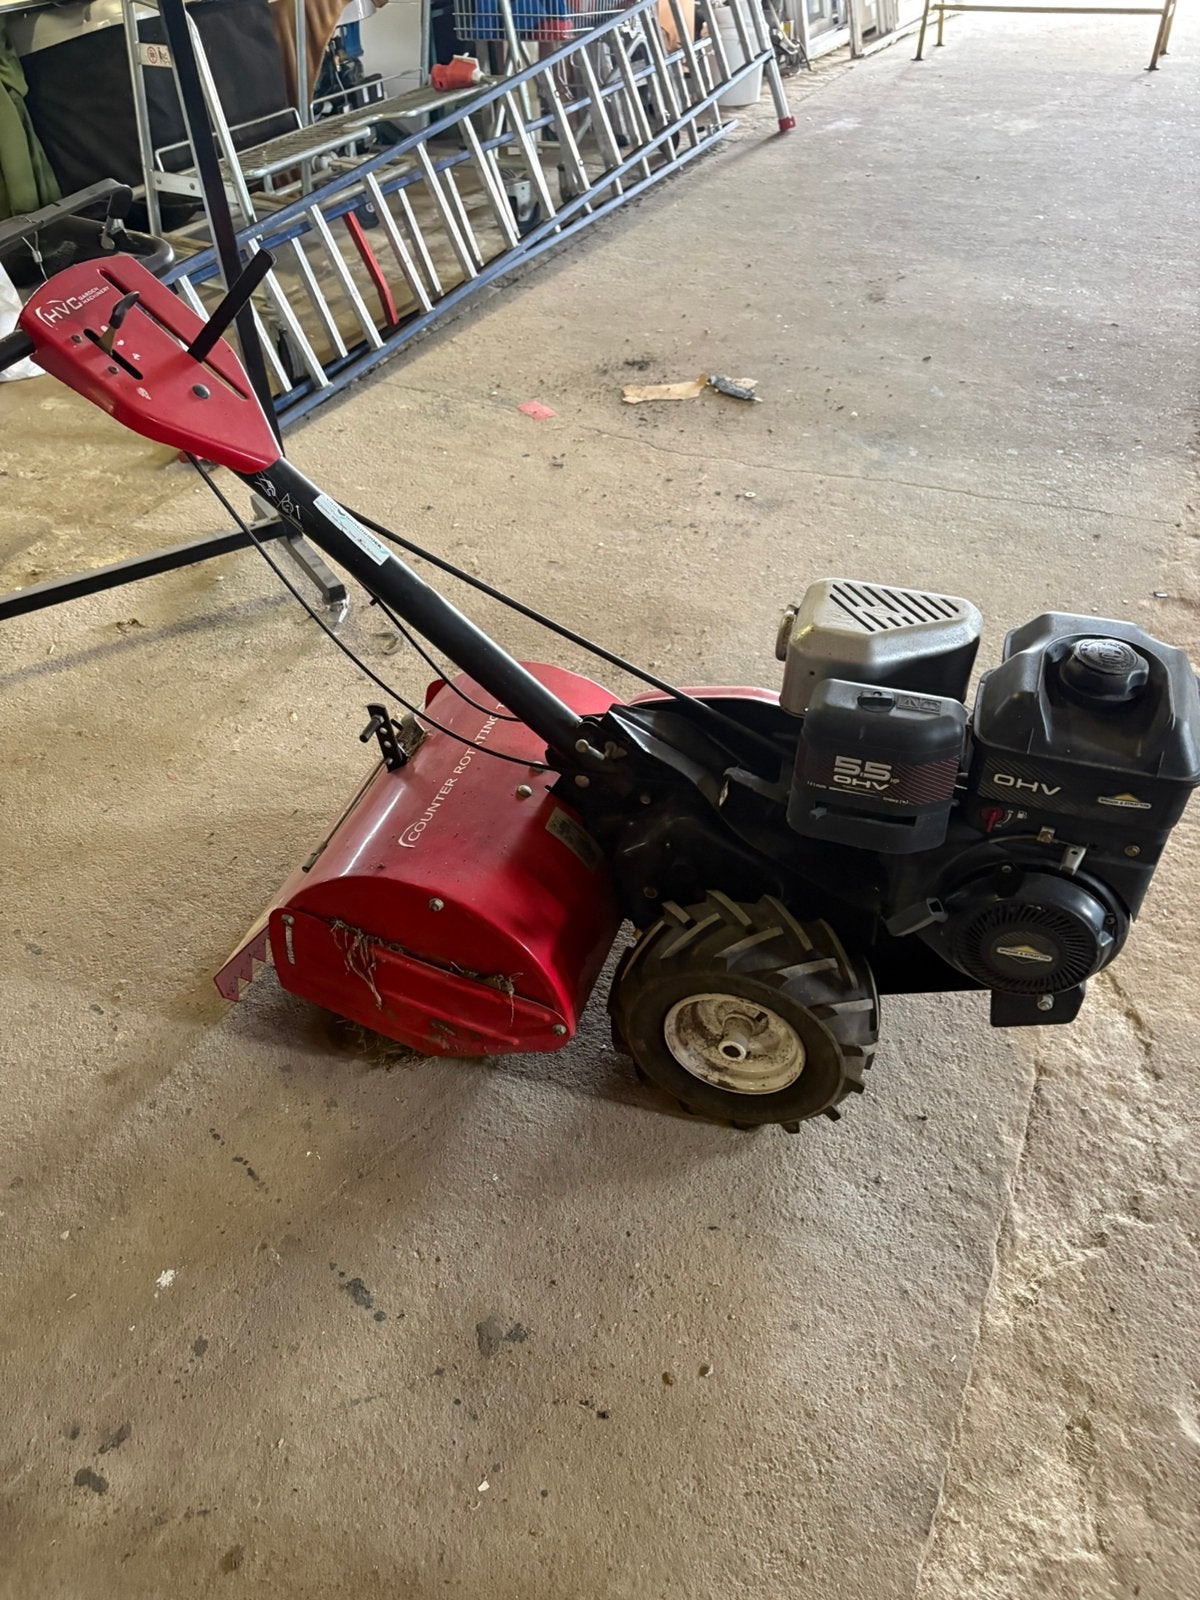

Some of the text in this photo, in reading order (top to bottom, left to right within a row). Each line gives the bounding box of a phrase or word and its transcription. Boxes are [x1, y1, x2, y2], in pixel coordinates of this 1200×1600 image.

[43, 296, 83, 323] HVC
[833, 774, 890, 791] OHV
[992, 772, 1062, 796] OHV
[407, 778, 458, 842] COUNTER
